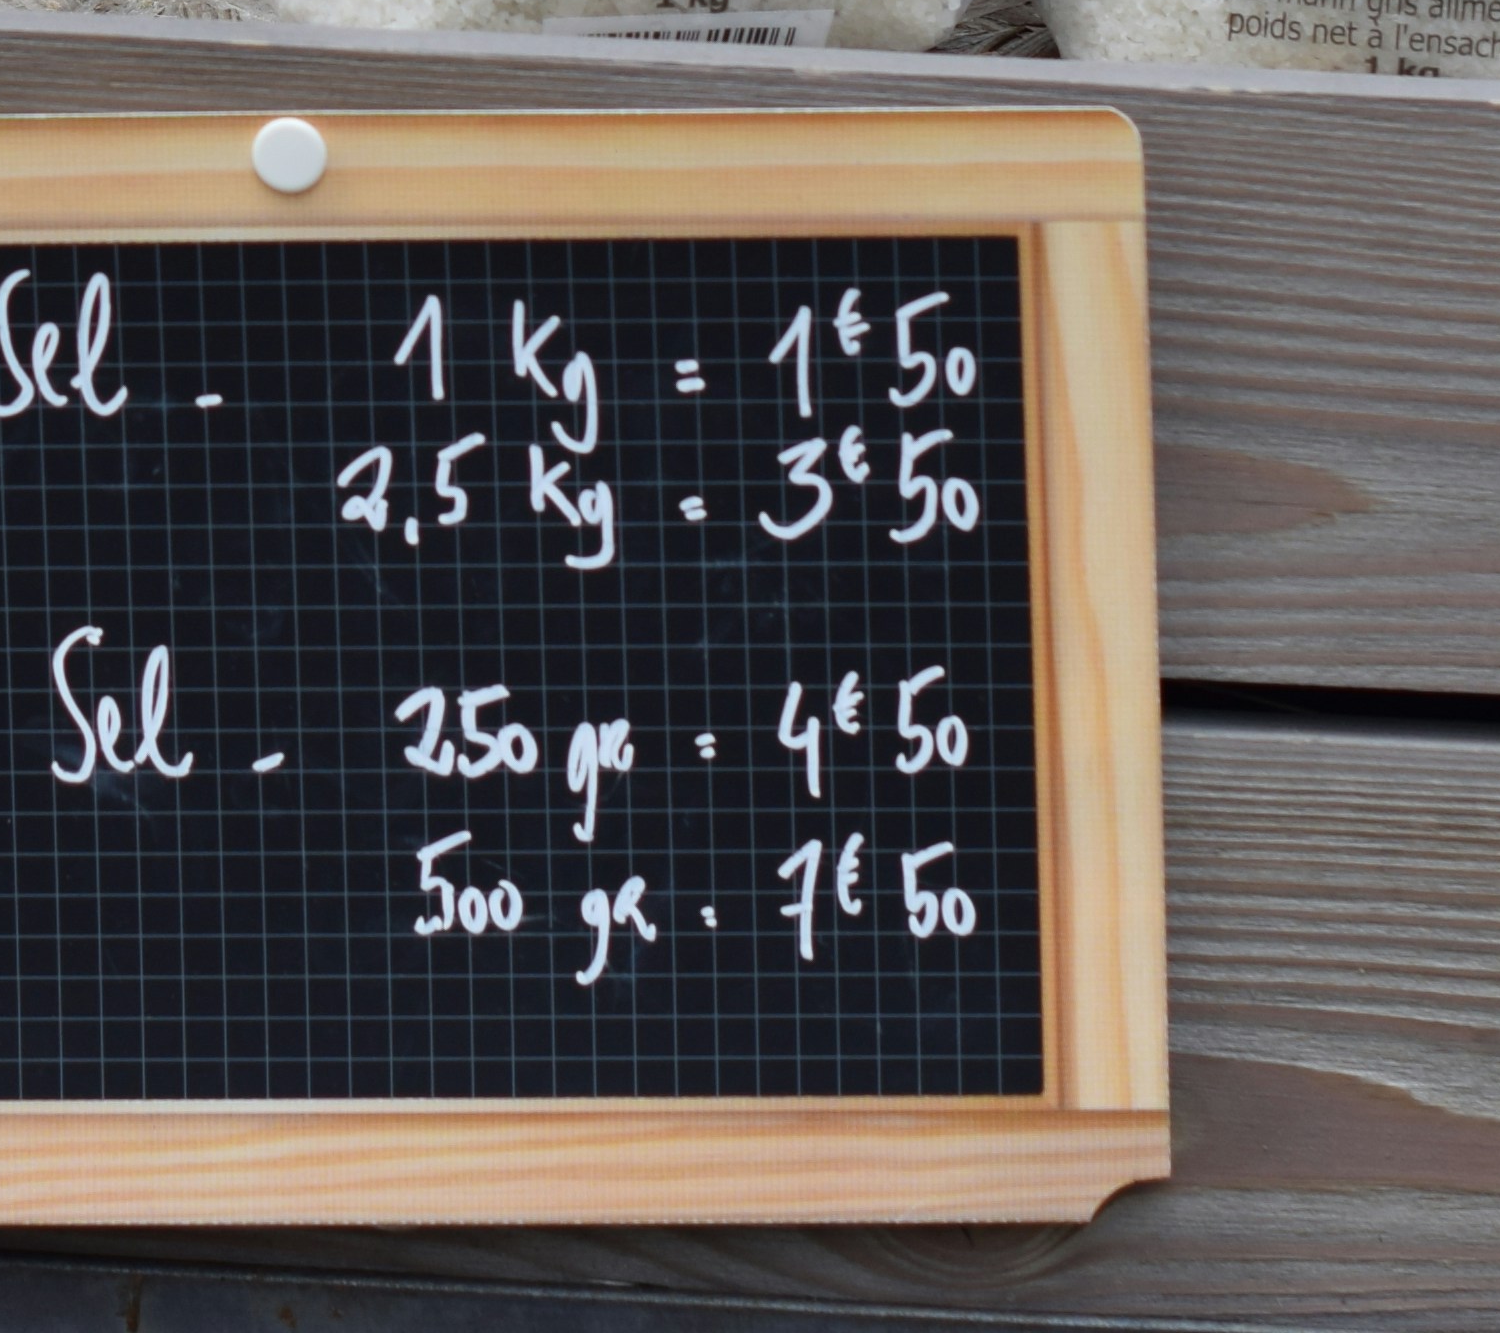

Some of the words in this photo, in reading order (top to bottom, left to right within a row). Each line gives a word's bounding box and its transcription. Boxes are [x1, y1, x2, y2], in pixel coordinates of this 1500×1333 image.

[1227, 11, 1300, 41] poids
[1312, 21, 1356, 46] net
[1368, 18, 1382, 48] à
[395, 296, 443, 399] 1
[338, 434, 484, 544] 2,5
[52, 626, 193, 782] Sel
[396, 685, 537, 777] 250
[415, 831, 522, 935] 500
